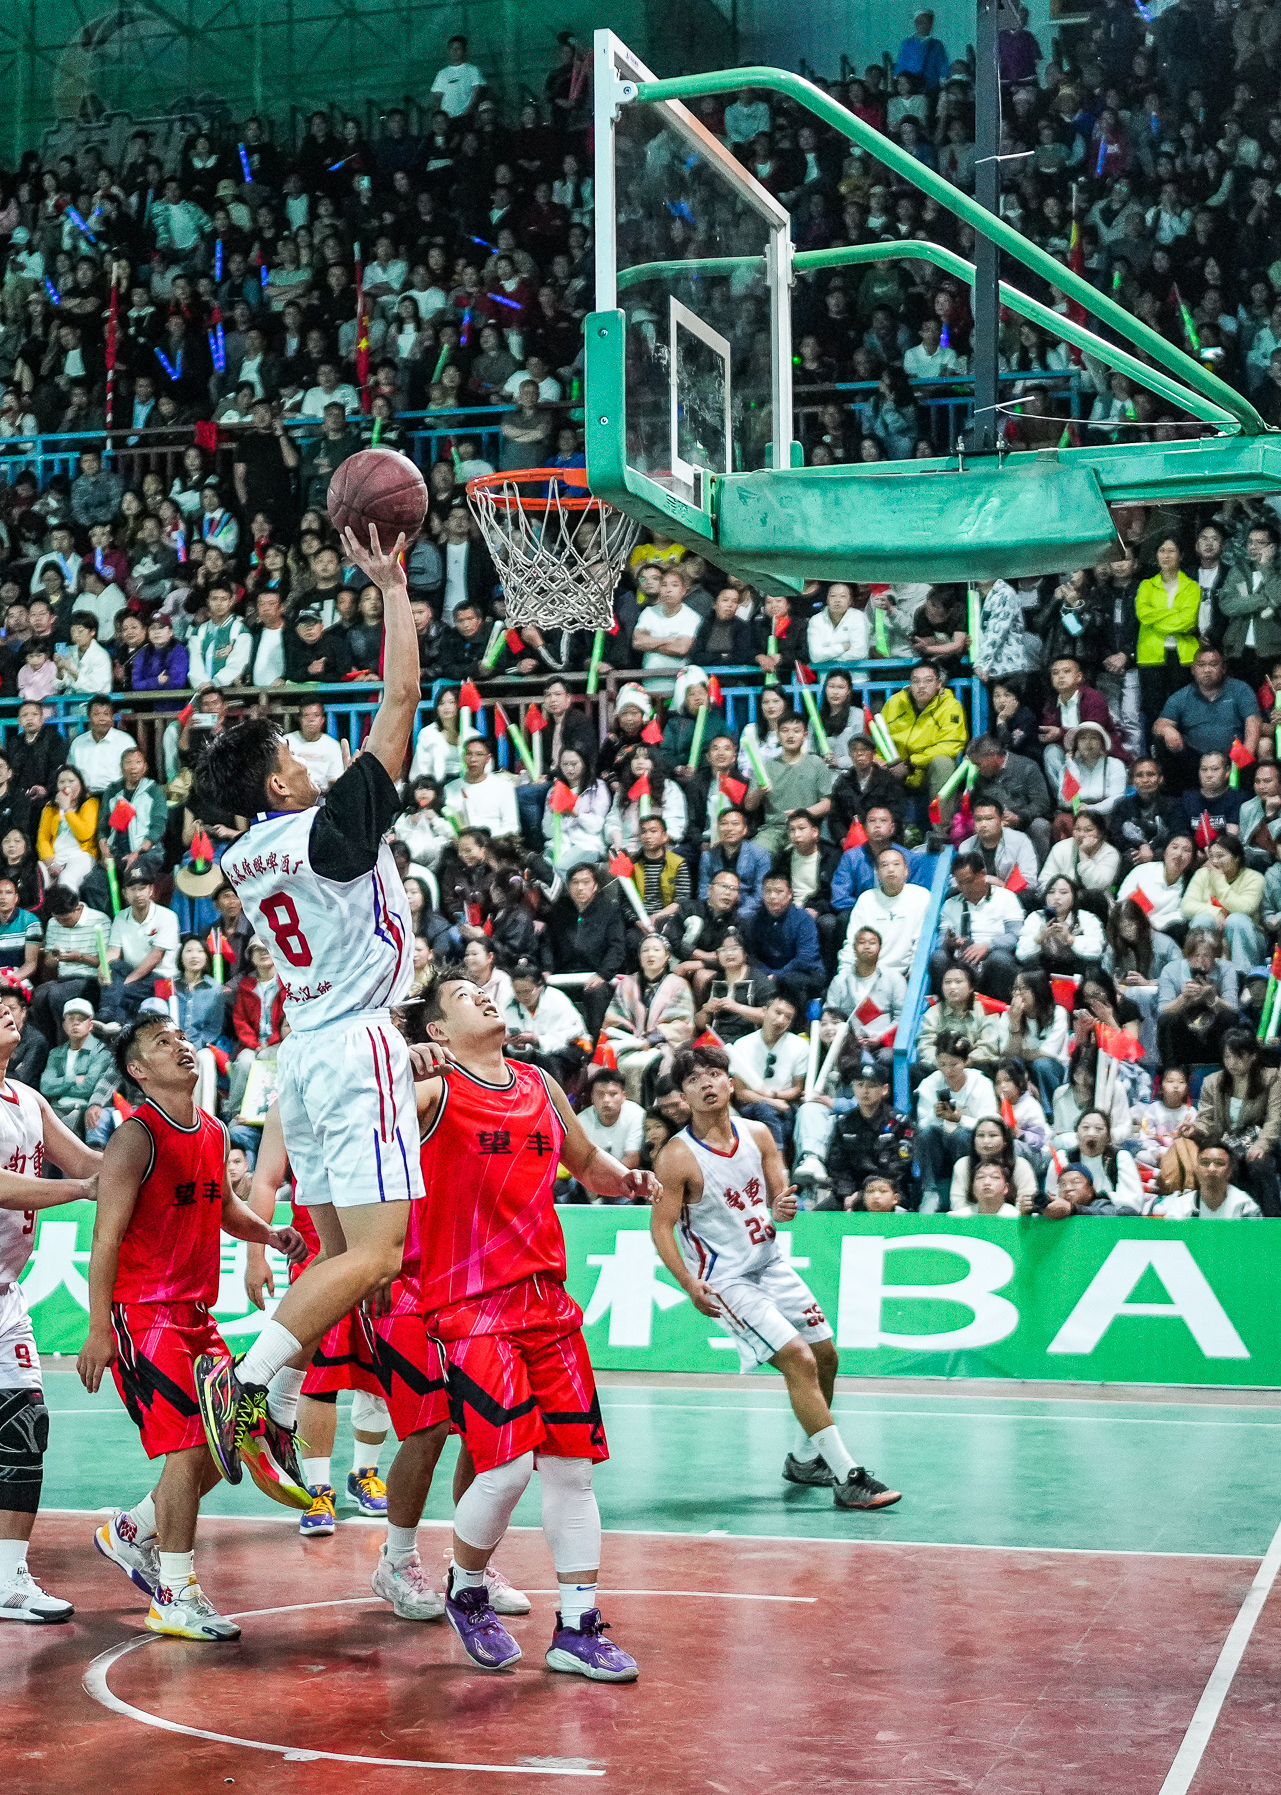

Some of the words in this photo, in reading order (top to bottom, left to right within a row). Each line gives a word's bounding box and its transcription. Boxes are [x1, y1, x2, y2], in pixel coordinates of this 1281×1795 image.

[259, 891, 313, 967] 8
[476, 1130, 554, 1157] 望丰
[172, 1179, 222, 1206] 望丰
[14, 1343, 32, 1369] 9
